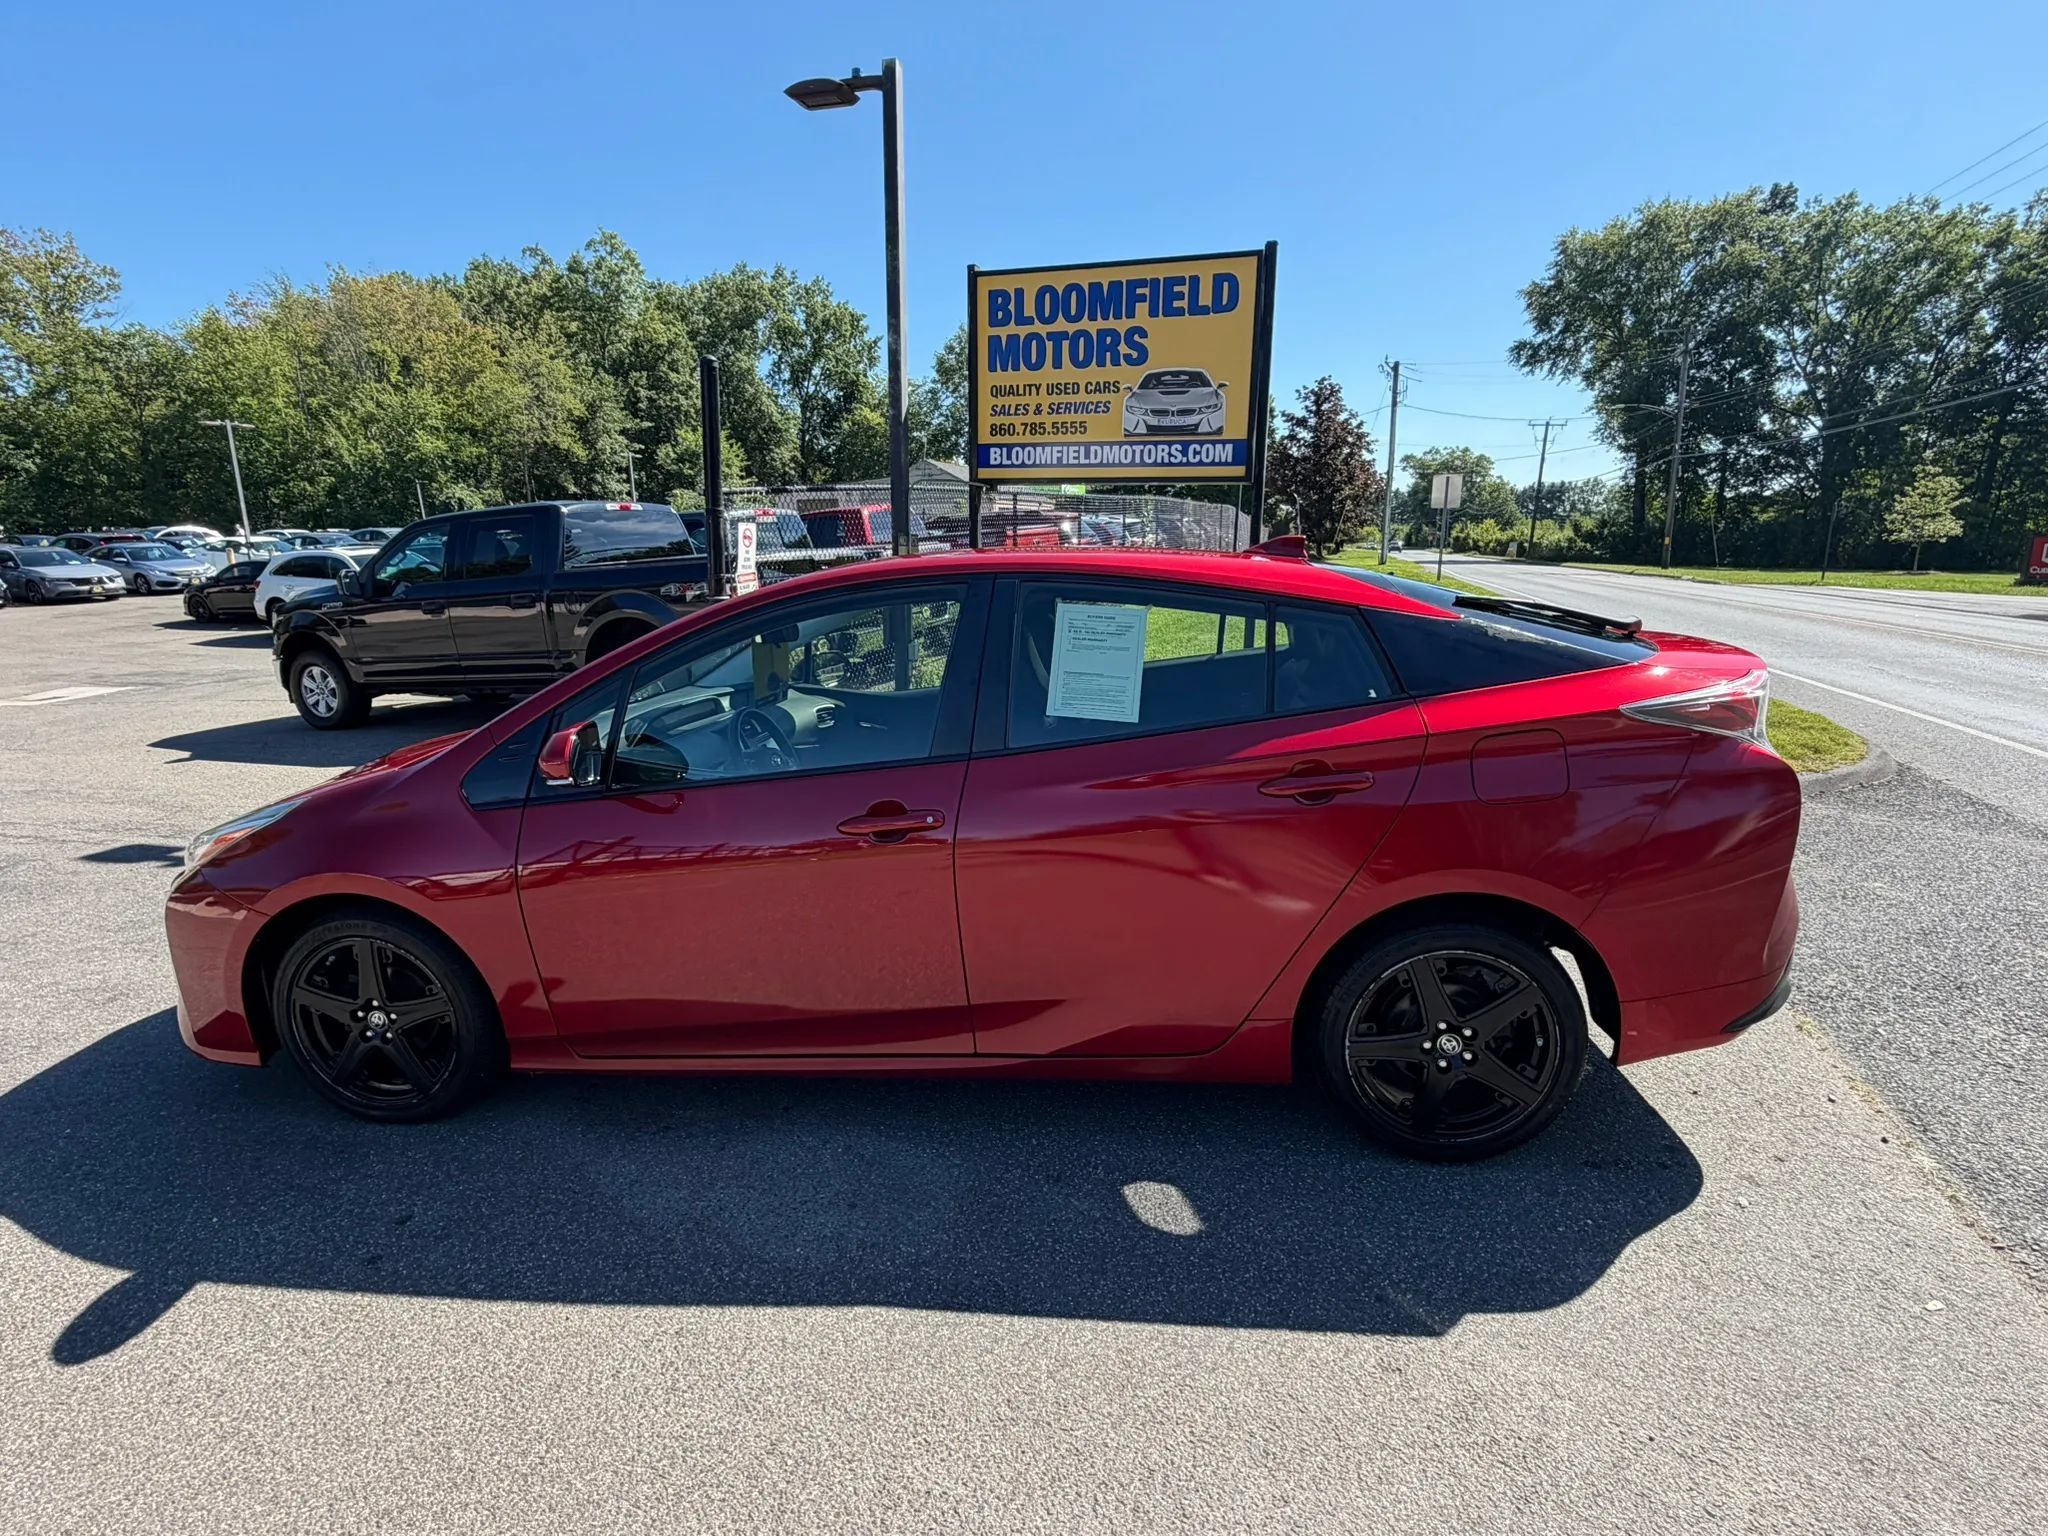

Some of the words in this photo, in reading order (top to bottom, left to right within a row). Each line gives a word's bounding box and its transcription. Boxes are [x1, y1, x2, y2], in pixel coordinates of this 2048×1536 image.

[988, 272, 1239, 328] BLOOMFIELD
[987, 326, 1150, 373] MOTORS
[990, 383, 1042, 399] QUALITY
[1046, 381, 1080, 396] USED
[1084, 380, 1121, 395] CARS
[989, 403, 1030, 417] SALES
[1033, 402, 1044, 416] &
[1047, 400, 1112, 416] SERVICES
[989, 420, 1088, 437] 860.785.5555
[989, 443, 1233, 466] BLOOMFIELDMOTORS.COM
